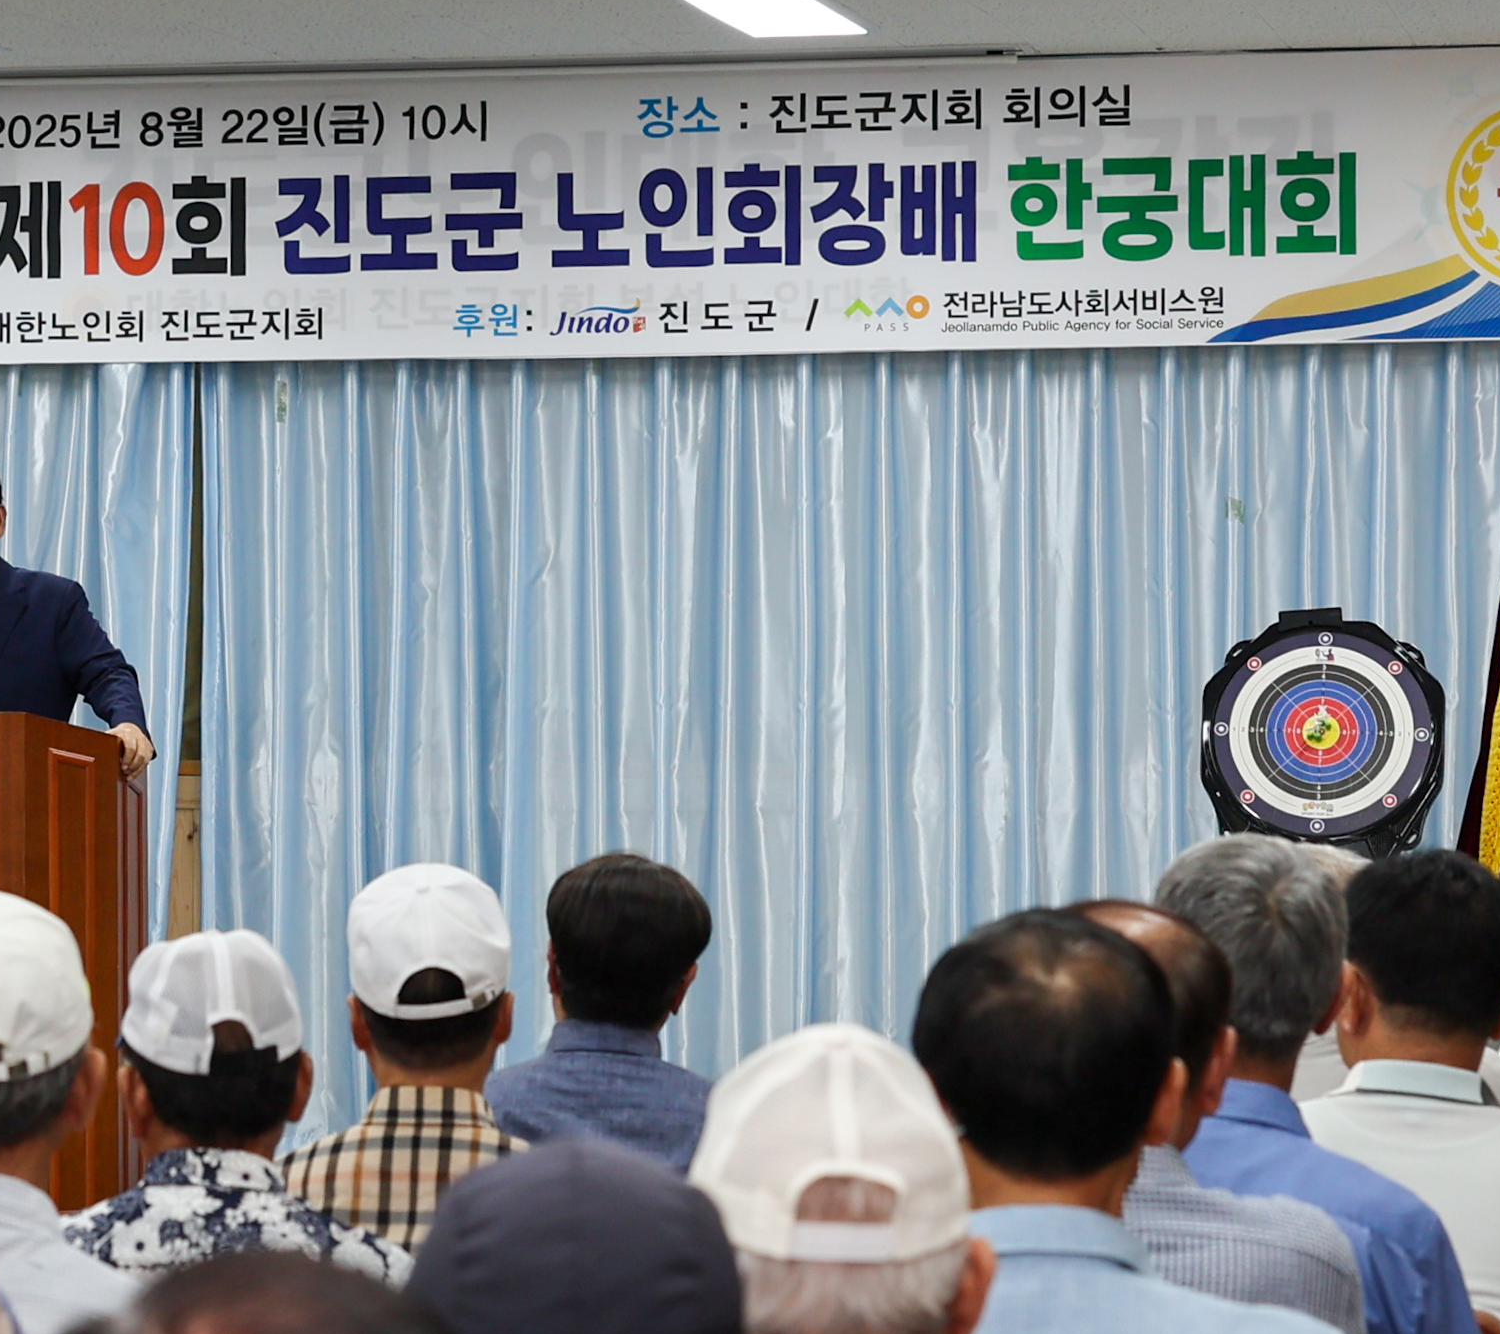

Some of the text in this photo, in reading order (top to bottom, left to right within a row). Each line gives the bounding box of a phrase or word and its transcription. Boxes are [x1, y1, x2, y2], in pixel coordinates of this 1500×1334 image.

[138, 107, 204, 147] 8월
[220, 101, 386, 146] 22일(금)
[401, 101, 488, 143] 10시
[636, 96, 720, 138] 장소
[767, 88, 984, 133] 진도군지회
[1002, 84, 1133, 128] 회의실
[275, 171, 524, 275] 진도군
[550, 158, 978, 267] 노인회장배
[1007, 151, 1359, 261] 한궁대회
[943, 286, 1225, 318] 전라남도사회서비스원
[161, 307, 325, 343] 진도군지회
[941, 317, 1224, 334] Jeollanamdo Public Agency for Social Service
